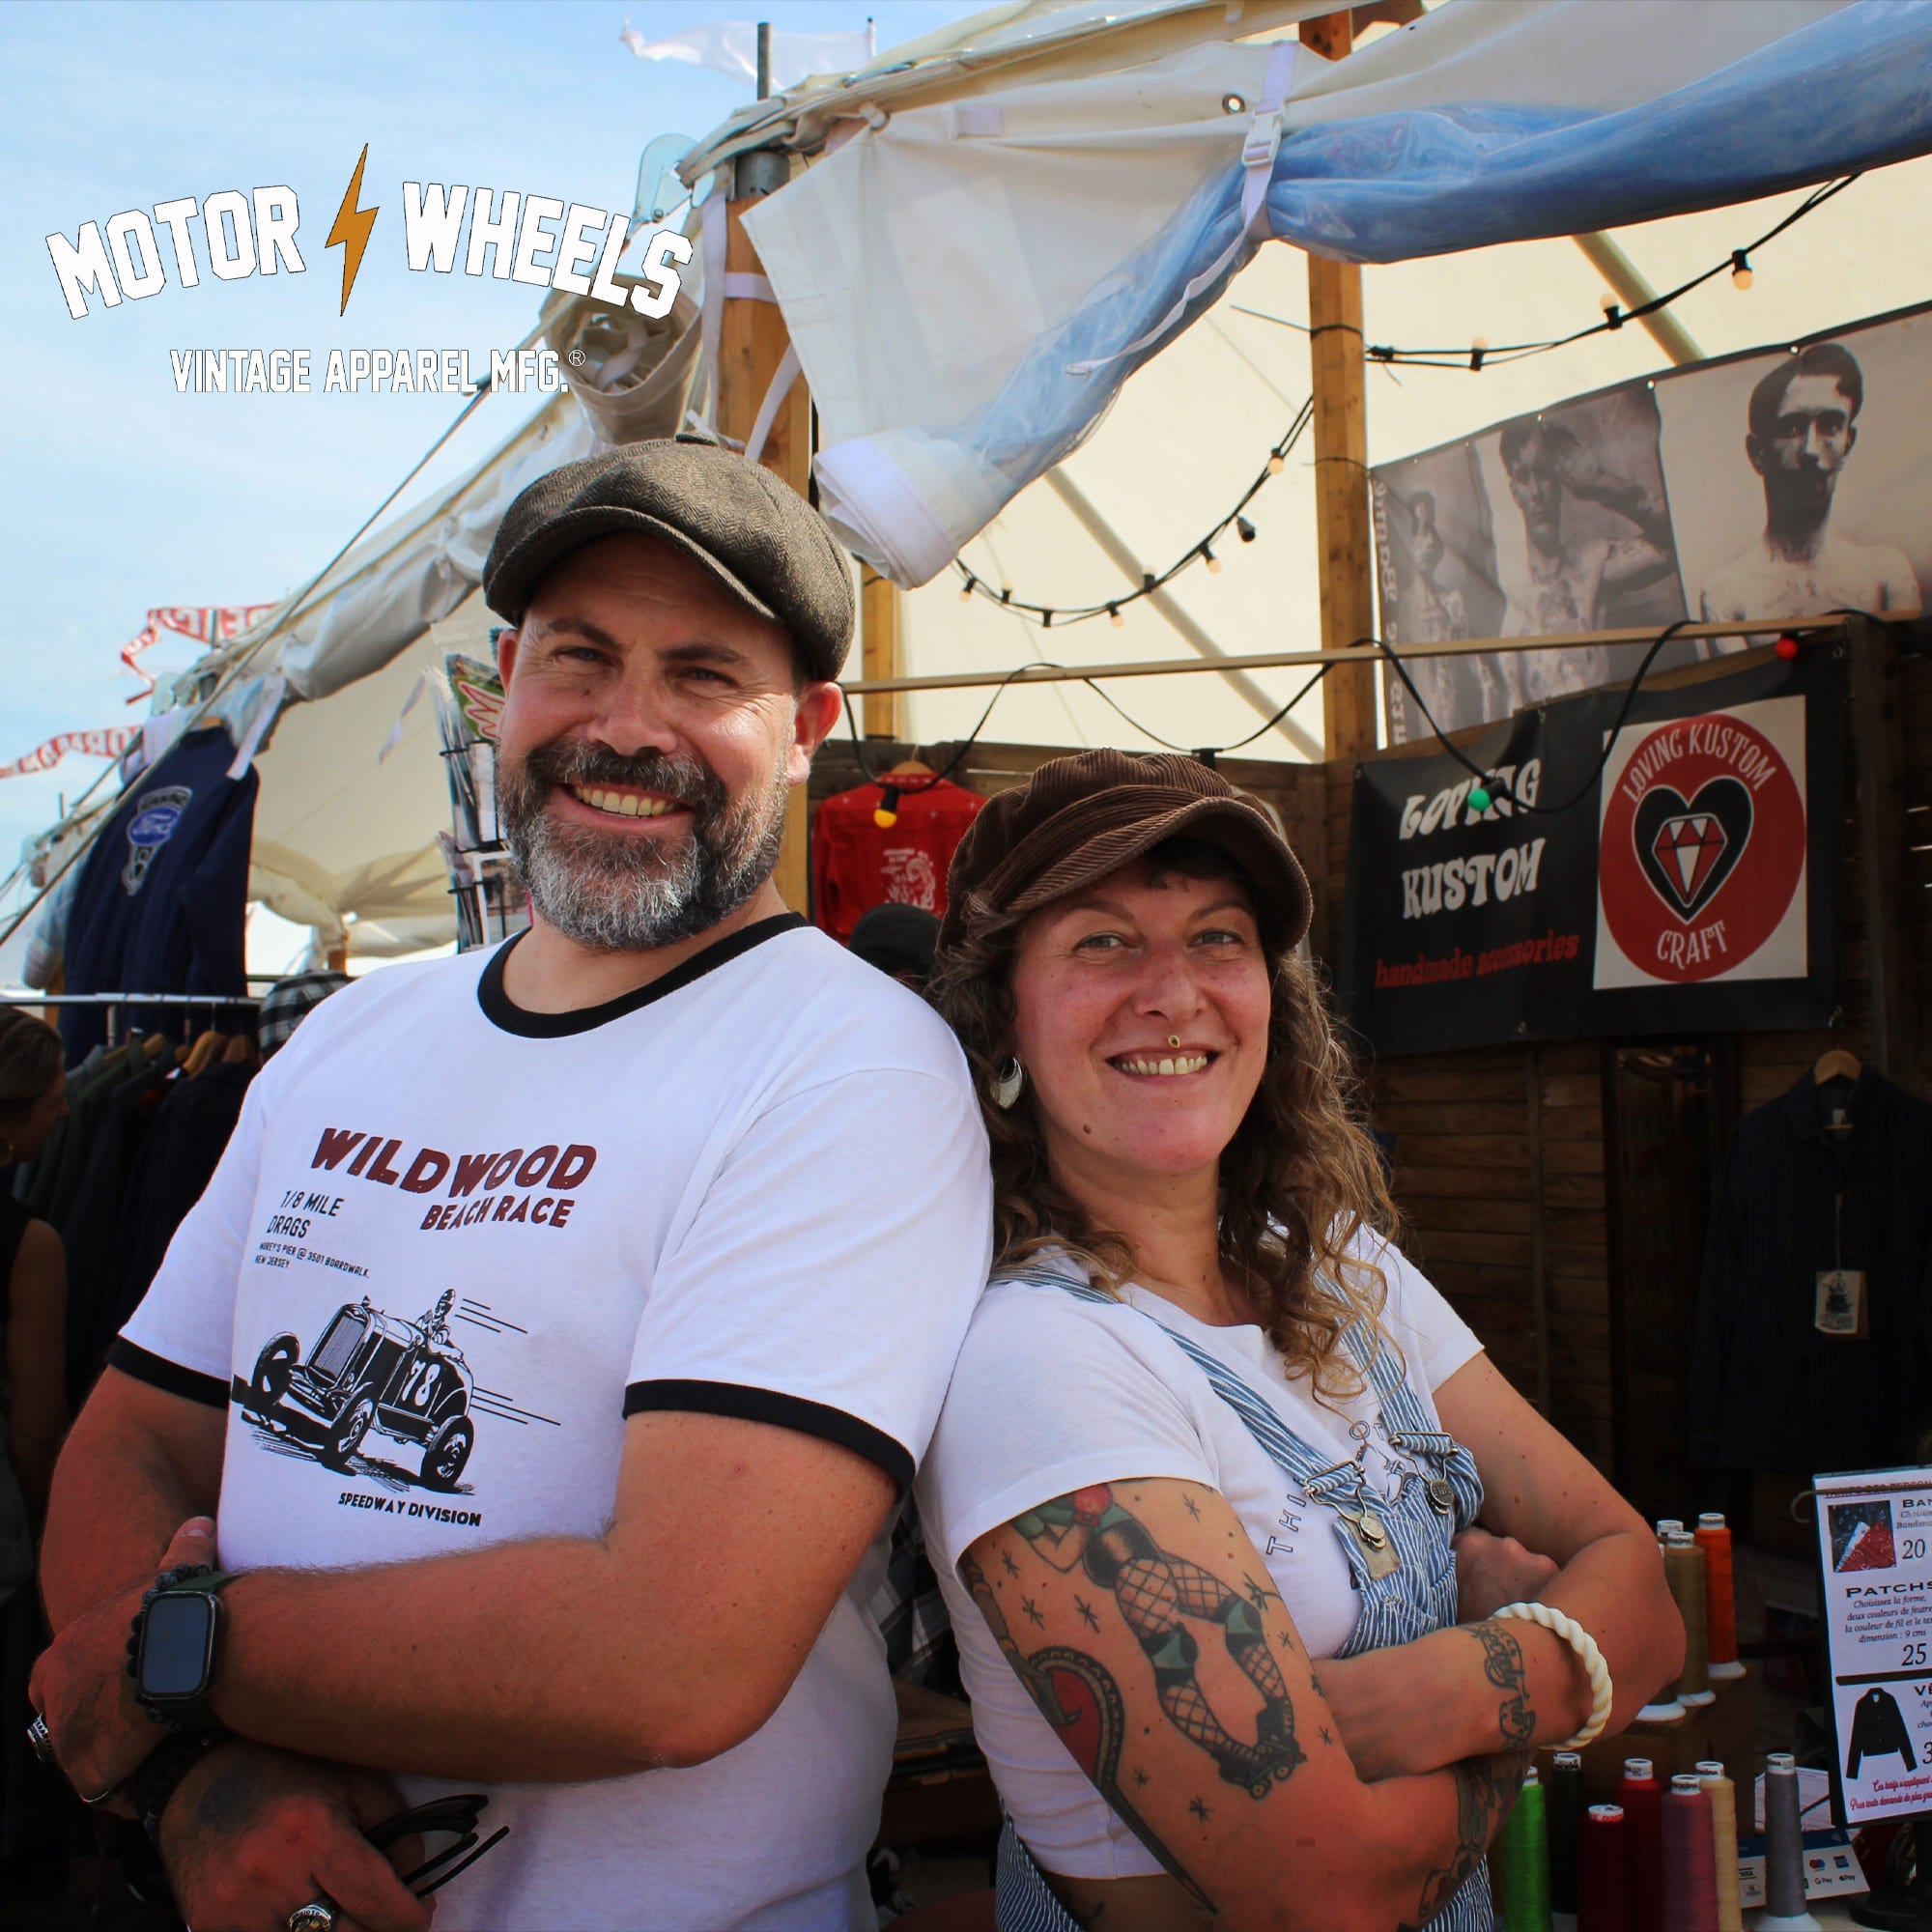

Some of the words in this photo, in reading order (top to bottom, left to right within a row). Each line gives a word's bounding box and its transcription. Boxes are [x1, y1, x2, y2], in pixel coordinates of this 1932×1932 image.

[1623, 722, 1684, 804] LOVING
[1689, 723, 1777, 791] KUSTOM
[1402, 838, 1546, 920] KUSTOM
[1658, 921, 1729, 970] CRAFT
[1374, 946, 1474, 989] handmade
[310, 1127, 597, 1199] WILDWOOD
[279, 1189, 305, 1208] 1/8
[302, 1192, 345, 1217] MILE
[420, 1201, 485, 1231] BEACH
[490, 1194, 576, 1229] RACE
[266, 1214, 311, 1238] DRAGS
[254, 1255, 267, 1264] NEW
[266, 1255, 291, 1269] JERSEY
[282, 1243, 297, 1256] PIER
[296, 1247, 308, 1261] @
[307, 1251, 326, 1264] 3501
[408, 1360, 443, 1406] 78
[338, 1492, 407, 1517] SPEEDWAY
[408, 1502, 482, 1528] DIVISION
[1901, 1538, 1926, 1560] 20
[1846, 1611, 1865, 1622] deux
[1866, 1608, 1899, 1620] couleurs
[1900, 1606, 1910, 1616] de
[1853, 1599, 1891, 1609] Choisissez
[1893, 1597, 1901, 1605] la
[1845, 1623, 1854, 1634] la
[1854, 1620, 1883, 1633] couleur
[1884, 1618, 1894, 1629] de
[1894, 1616, 1904, 1630] fil
[1906, 1617, 1914, 1626] et
[1915, 1615, 1921, 1625] le
[1858, 1632, 1898, 1644] dimension
[1912, 1630, 1926, 1638] cms
[1902, 1642, 1927, 1666] 25
